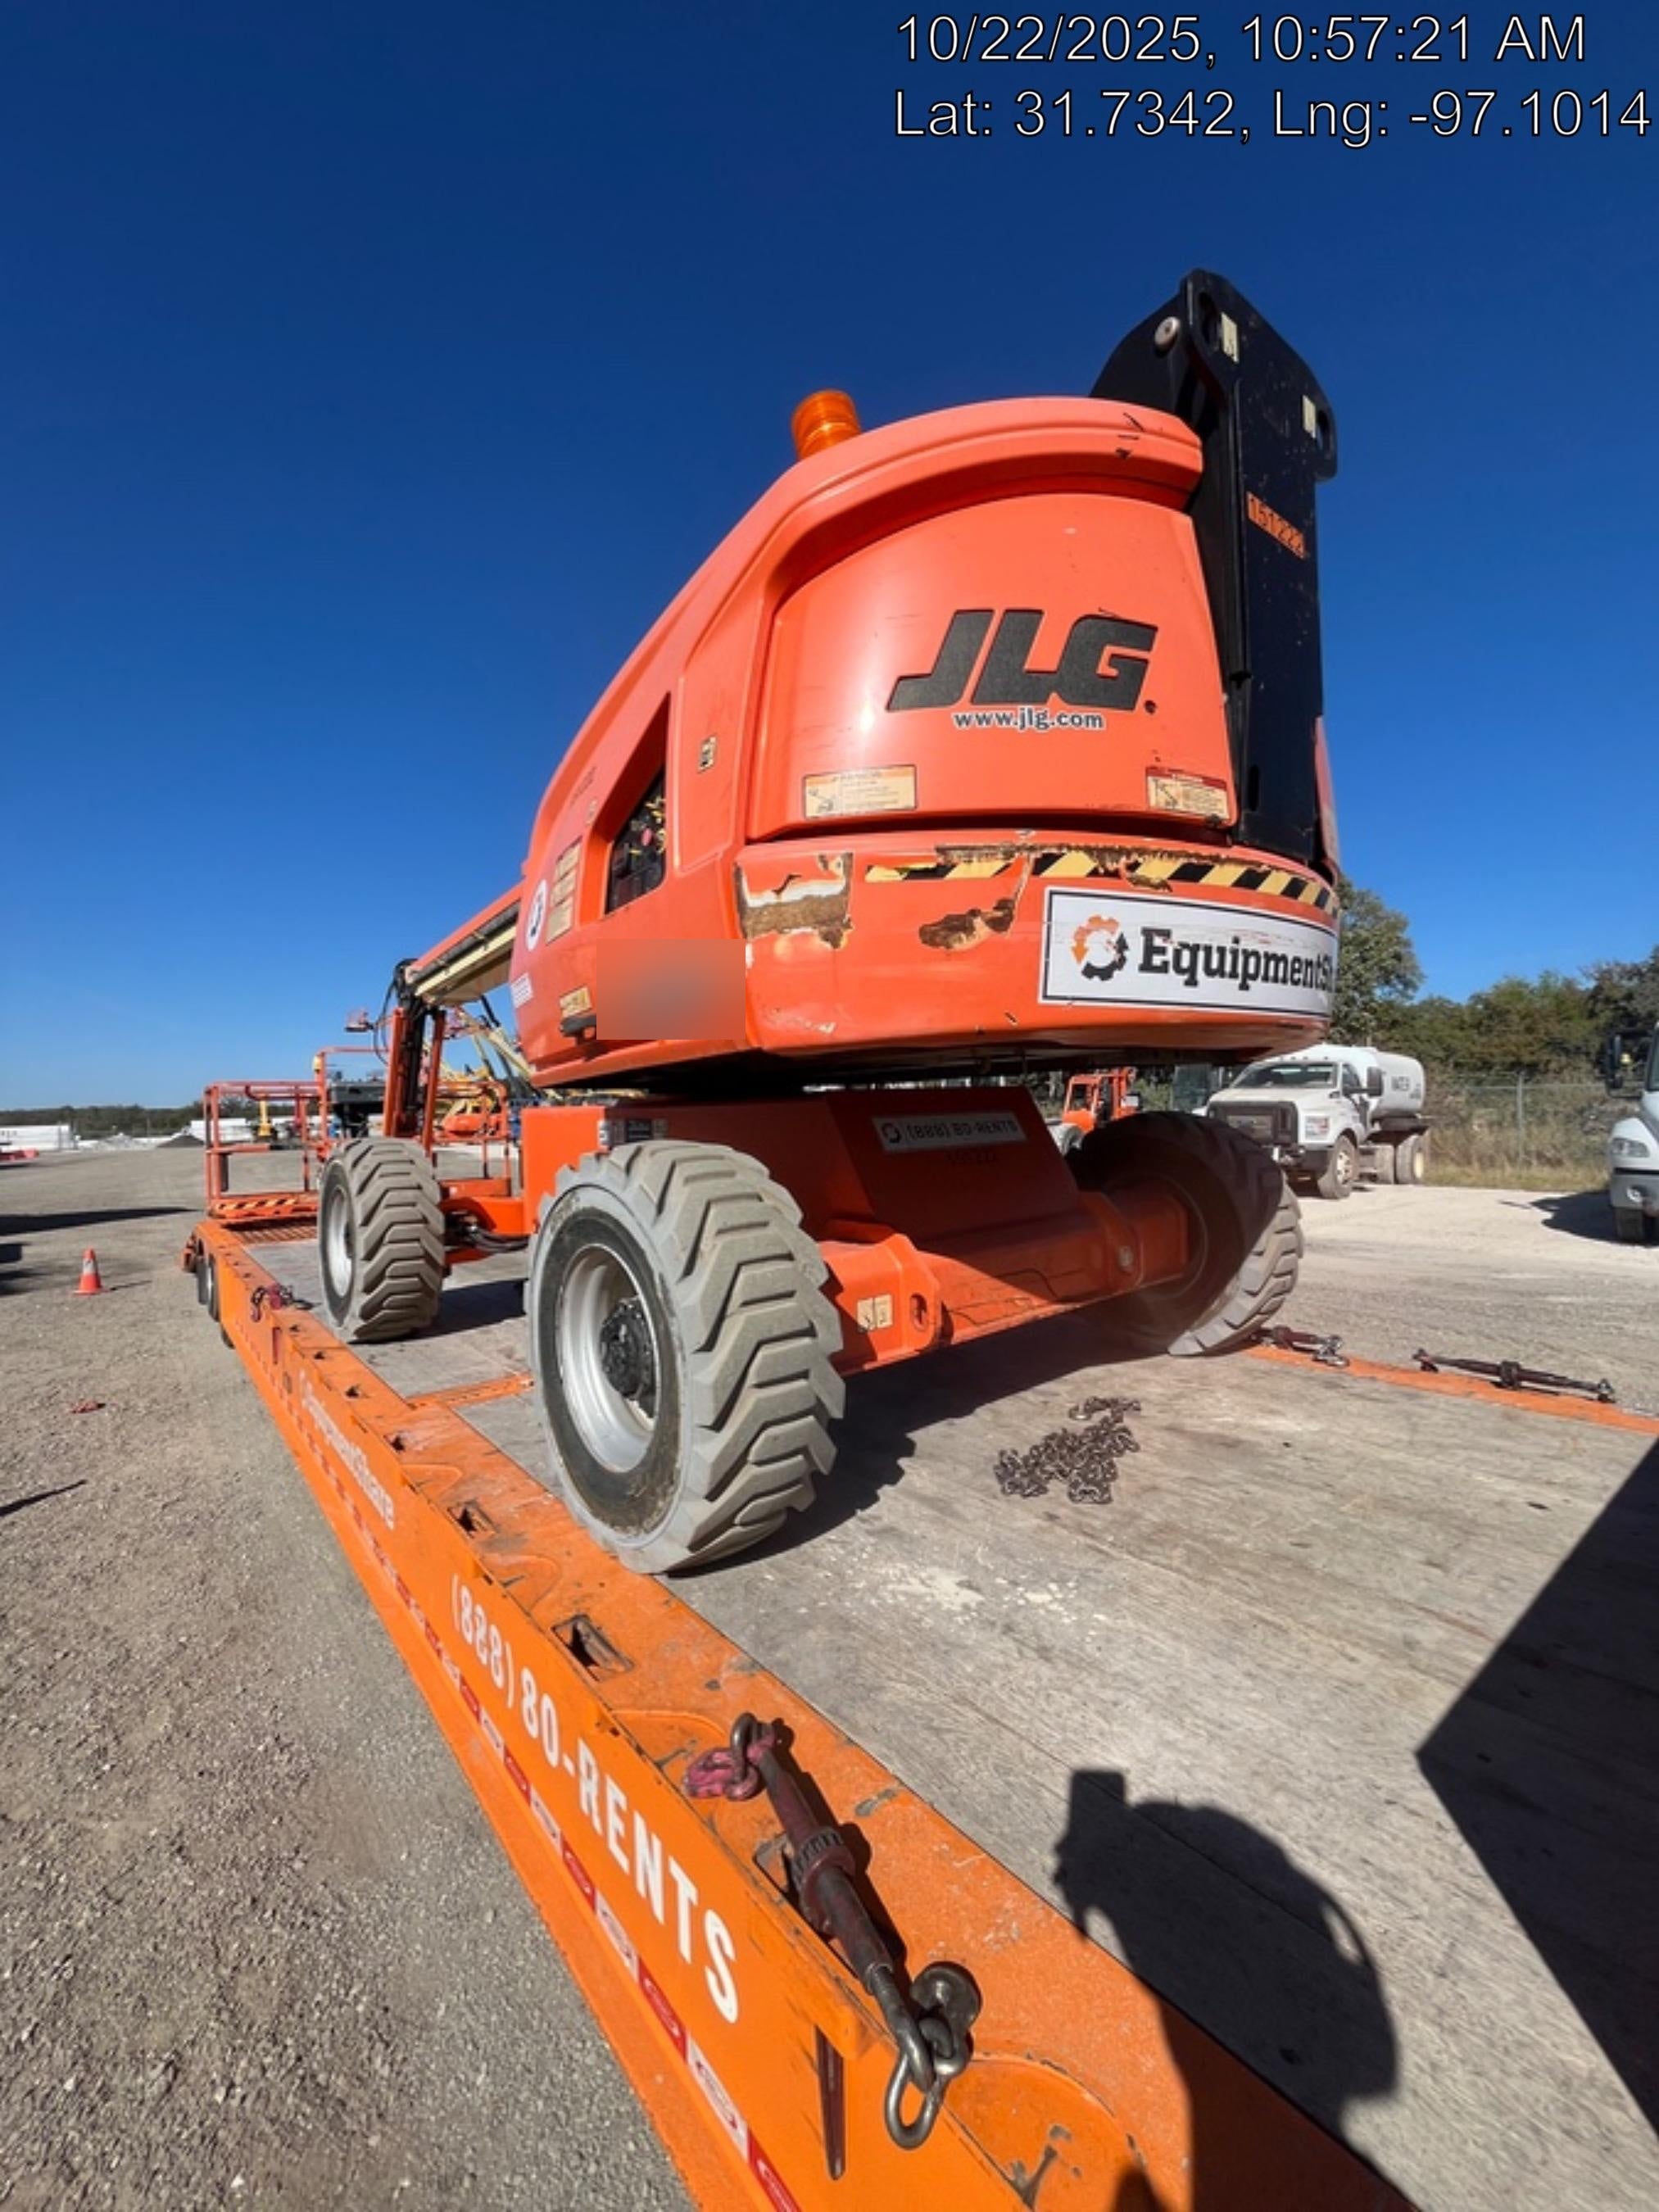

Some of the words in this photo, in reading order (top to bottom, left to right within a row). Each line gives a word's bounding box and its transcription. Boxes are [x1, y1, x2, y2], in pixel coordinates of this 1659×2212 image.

[886, 609, 1158, 711] JLG
[954, 707, 1104, 730] www.jlg.com
[1138, 926, 1335, 993] EquipmentS
[451, 1573, 514, 1709] (888)
[519, 1666, 738, 2024] 80-RENTS
